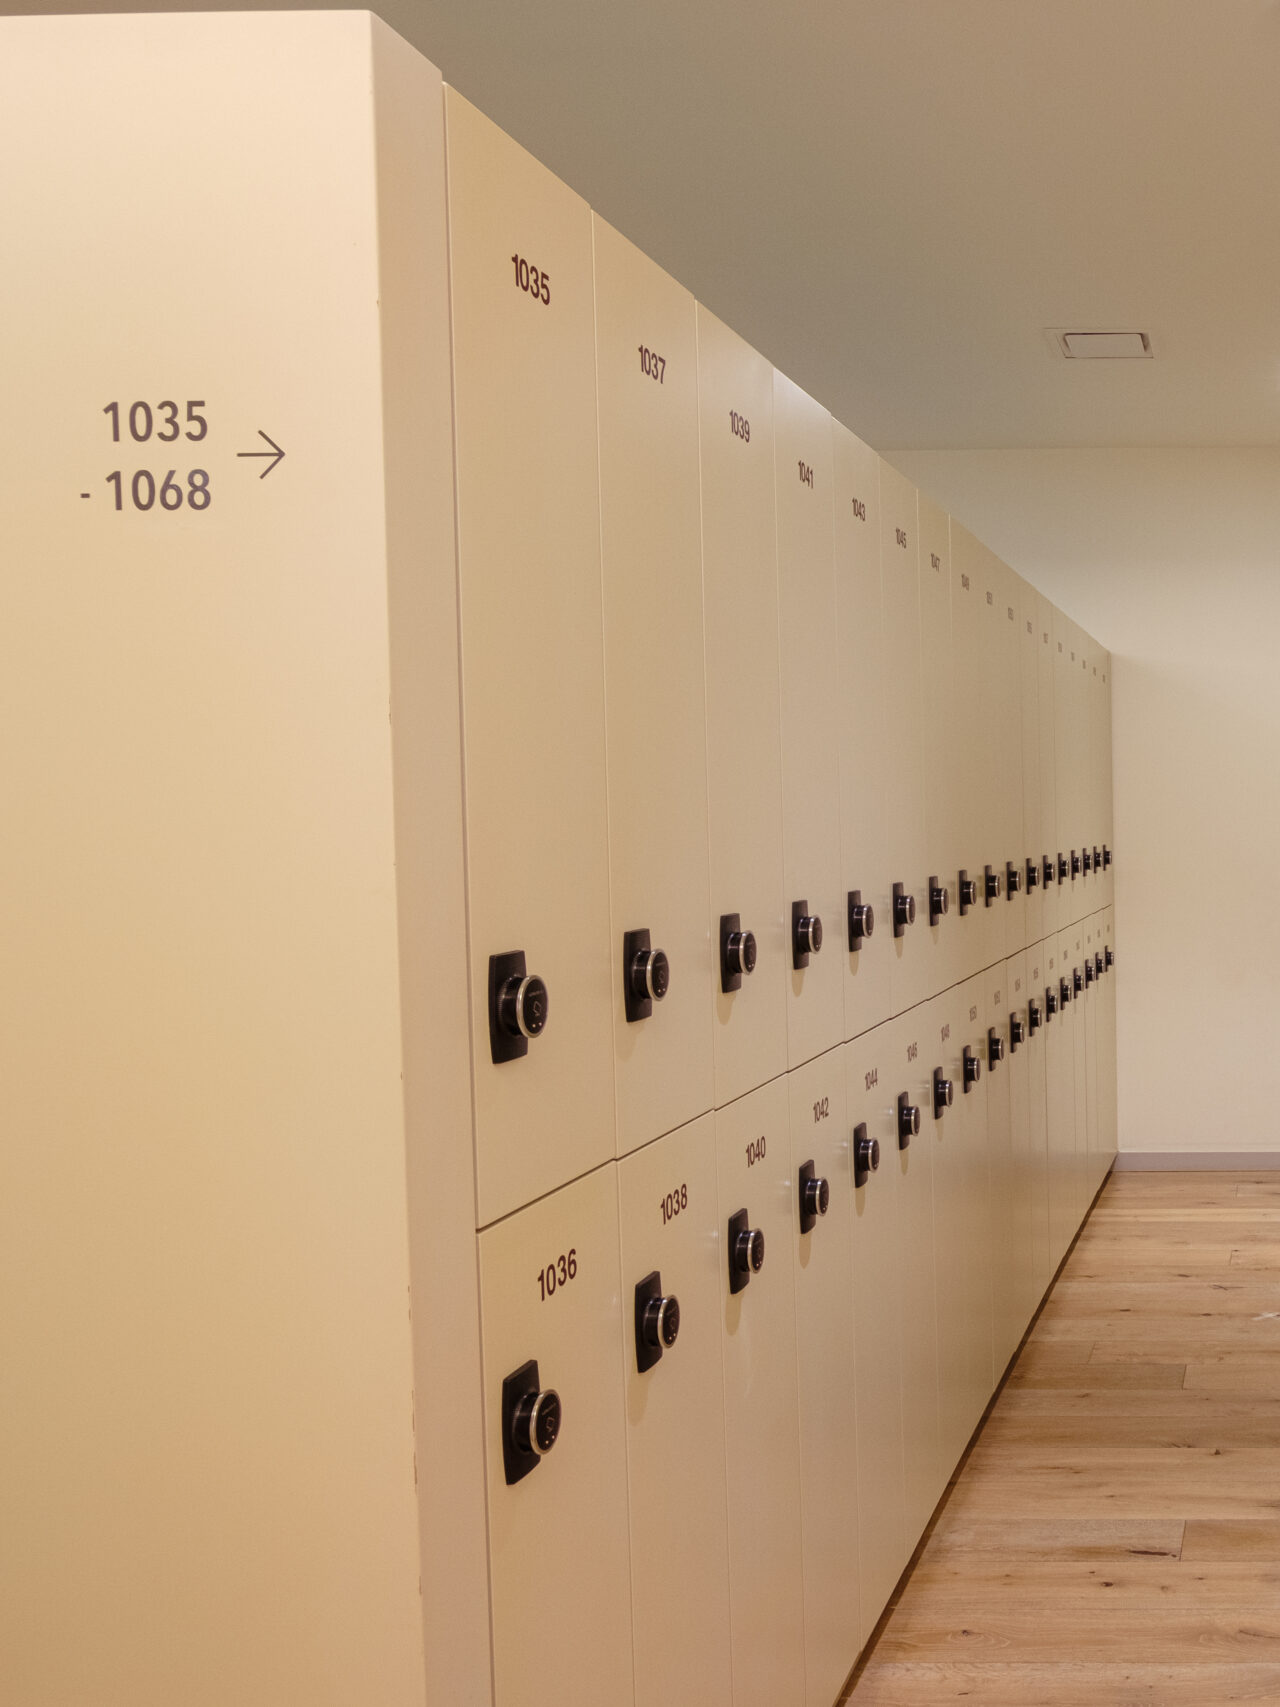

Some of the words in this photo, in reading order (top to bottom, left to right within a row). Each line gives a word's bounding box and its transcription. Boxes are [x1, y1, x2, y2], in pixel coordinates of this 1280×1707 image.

[511, 253, 550, 306] 1035
[638, 344, 666, 384] 1037
[103, 400, 208, 442] 1035
[729, 409, 750, 443] 1039
[798, 460, 814, 489] 1041
[852, 497, 866, 522] 1043
[813, 1096, 829, 1124] 1042
[745, 1135, 767, 1168] 1040
[660, 1183, 688, 1226] 1038
[537, 1248, 577, 1302] 1036
